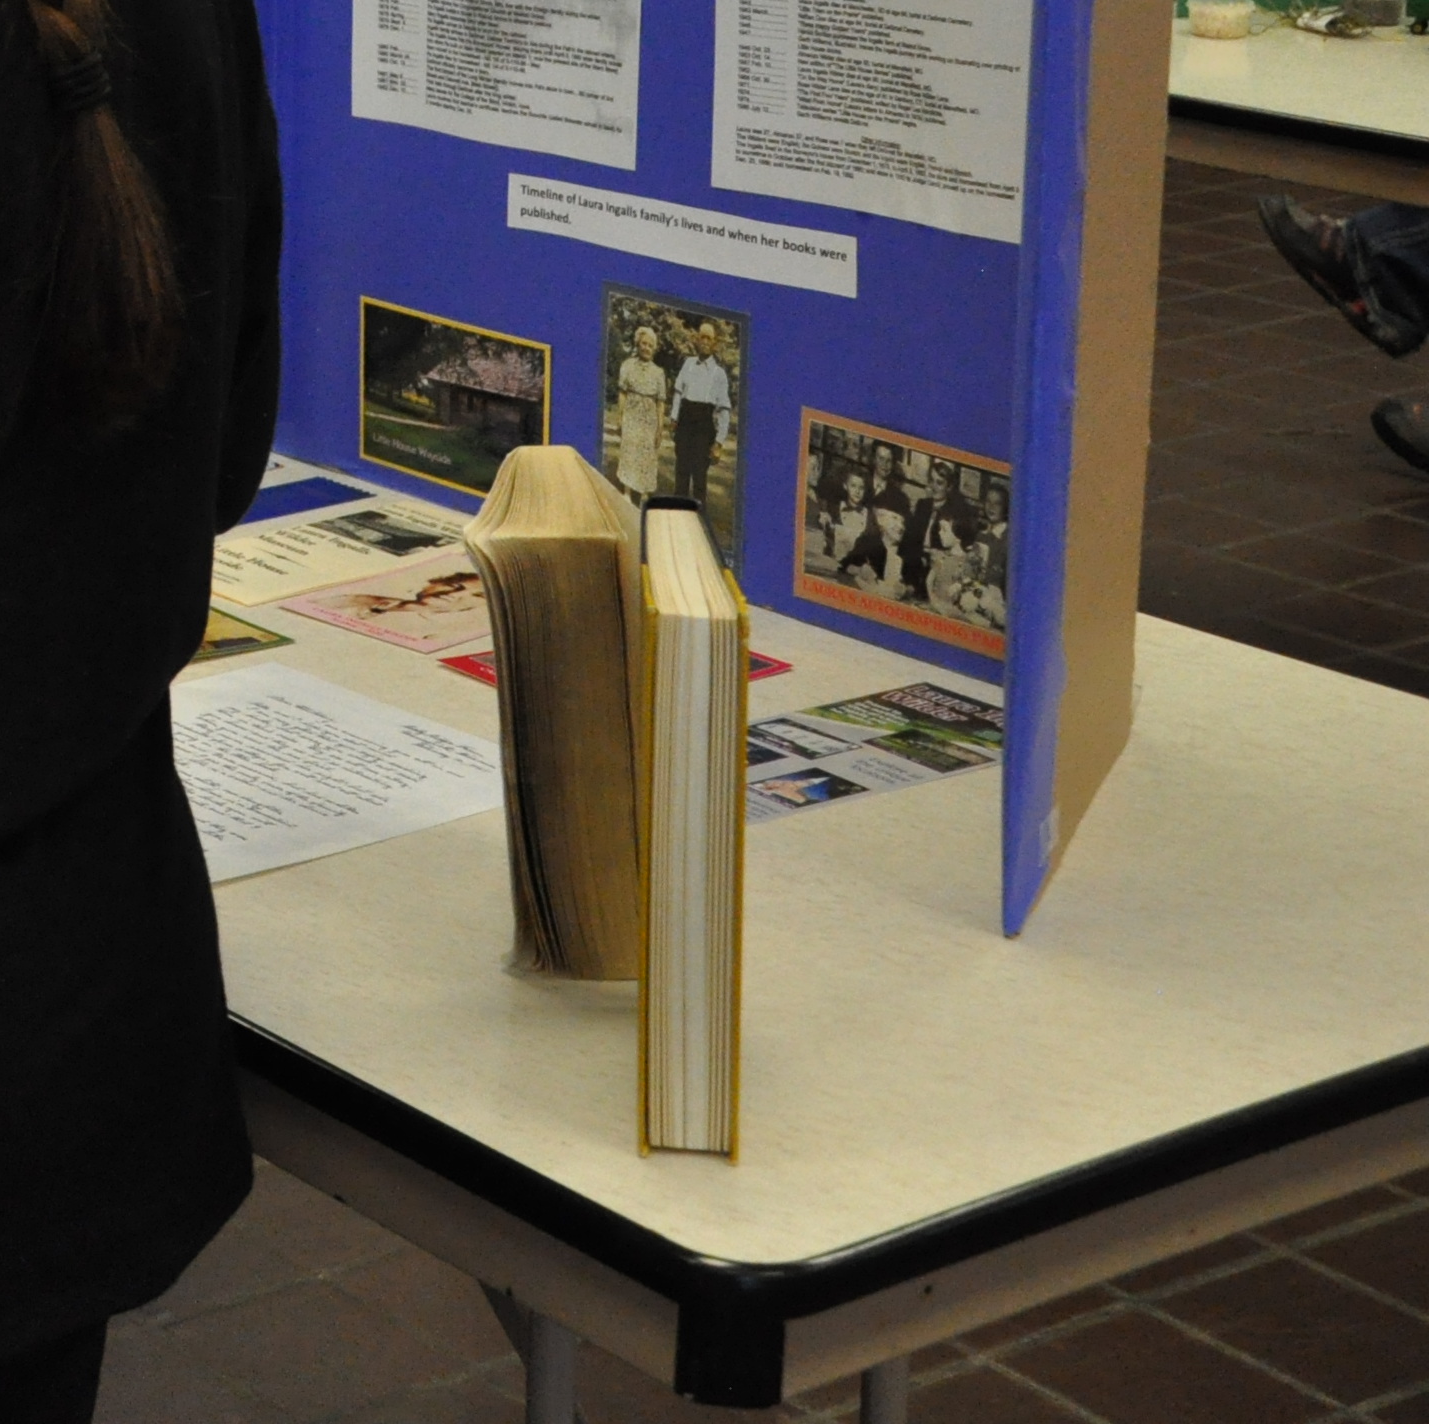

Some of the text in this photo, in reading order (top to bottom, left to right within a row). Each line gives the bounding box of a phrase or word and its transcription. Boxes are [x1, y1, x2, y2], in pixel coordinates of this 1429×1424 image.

[520, 205, 572, 225] published.
[520, 183, 848, 263] Timeline of Laura Ingalls family's lives and when her books were
